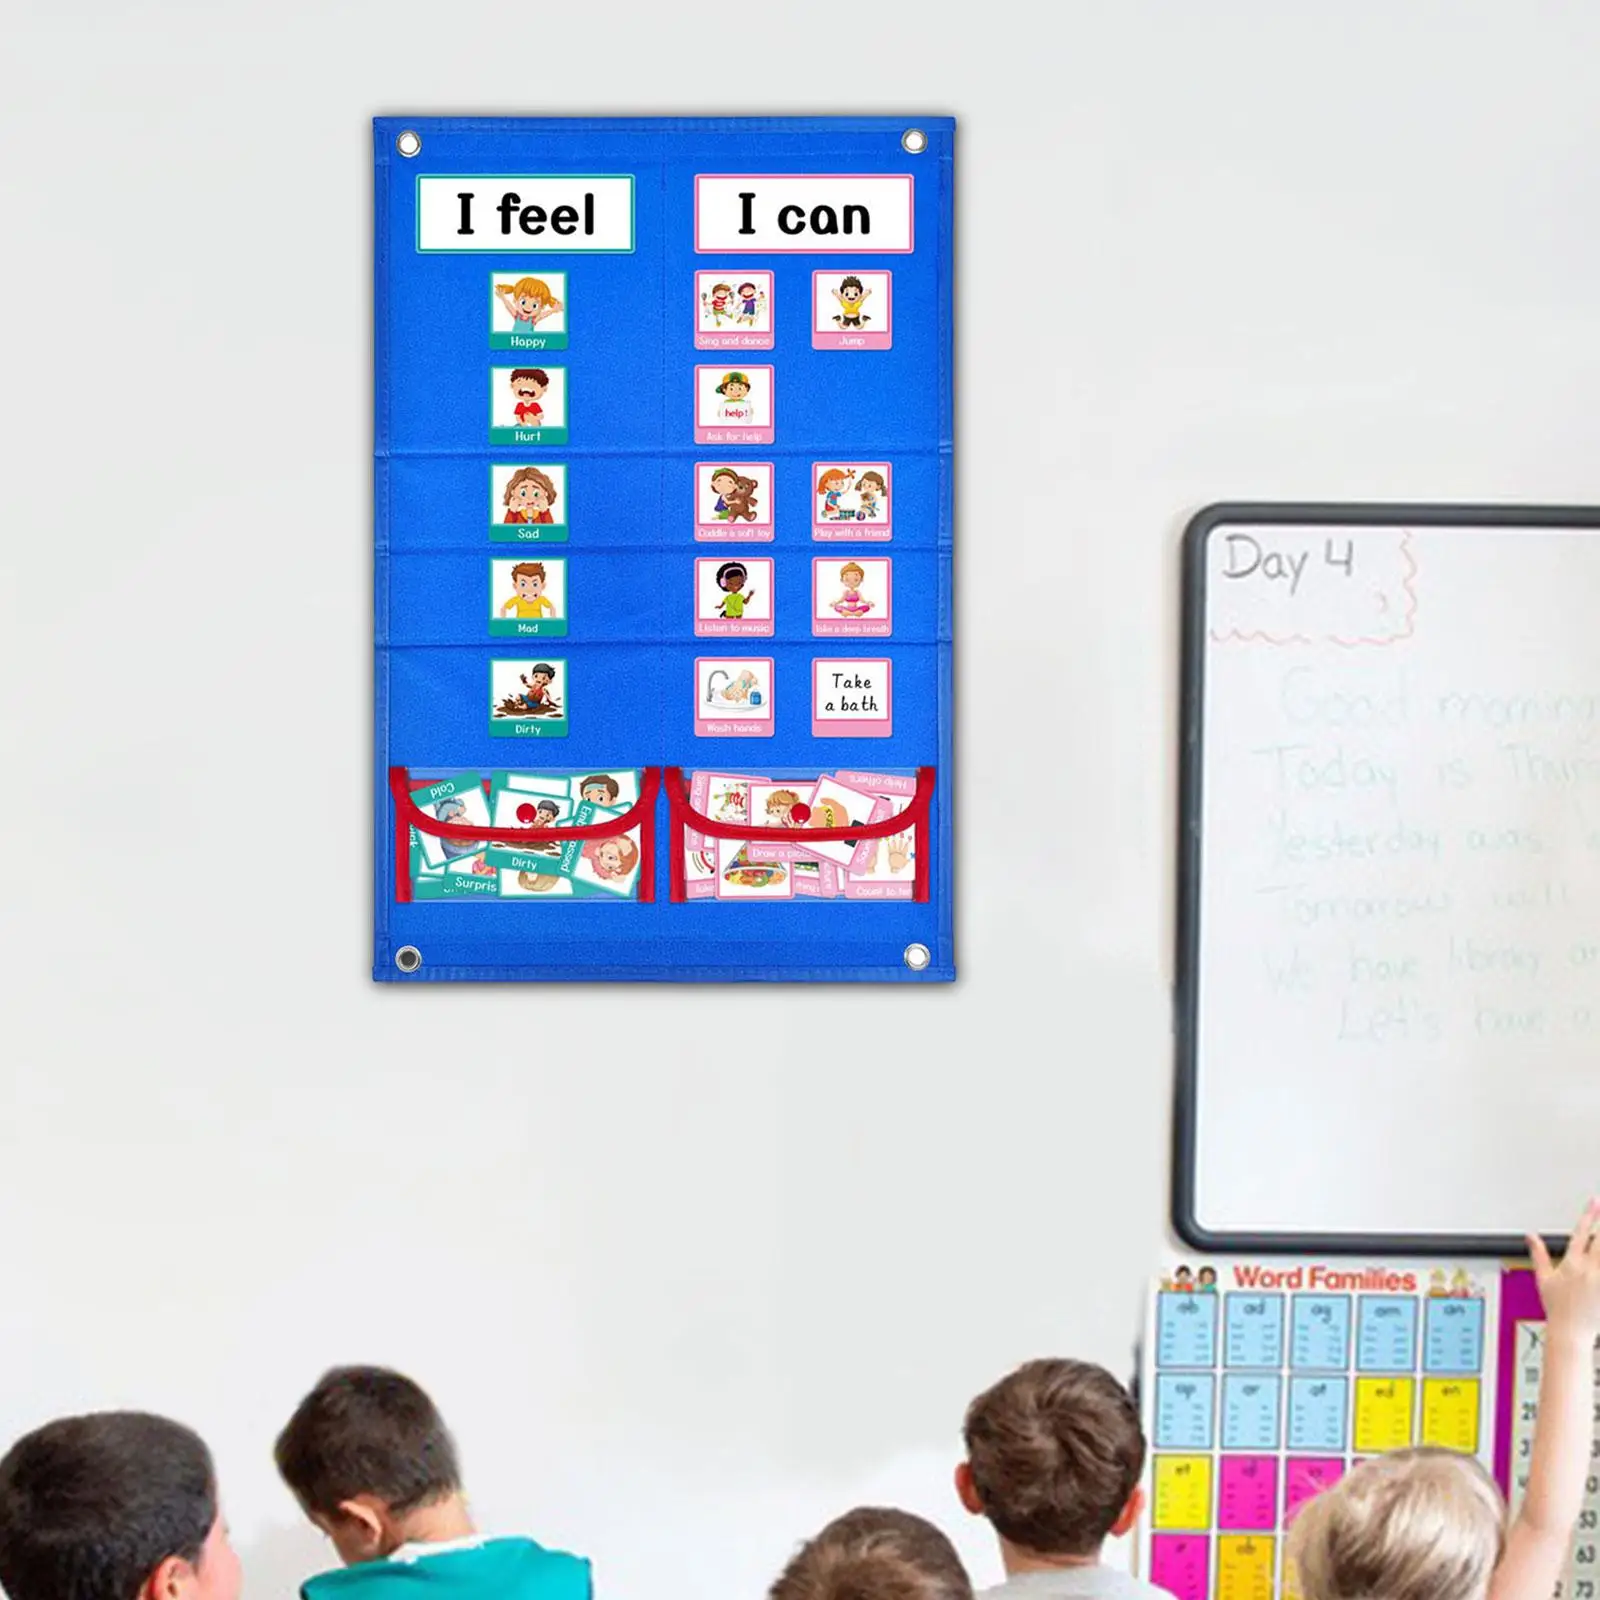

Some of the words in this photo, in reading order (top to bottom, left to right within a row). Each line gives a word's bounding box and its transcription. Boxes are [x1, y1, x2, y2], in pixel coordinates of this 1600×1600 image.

[457, 192, 475, 235] I
[496, 192, 594, 235] feel
[738, 192, 756, 235] I
[777, 204, 870, 235] can
[510, 335, 546, 348] Happy
[698, 335, 719, 347] Sing
[721, 335, 740, 345] and
[741, 335, 771, 345] dance
[838, 335, 866, 347] Jump
[515, 431, 541, 441] Hurt
[706, 431, 721, 441] Ask
[726, 431, 740, 441] for
[743, 431, 762, 443] help
[518, 528, 540, 538] Sad
[698, 528, 728, 538] Cuddle
[737, 528, 755, 538] soft
[757, 528, 771, 539] toy
[814, 528, 832, 539] Play
[834, 528, 854, 538] with
[863, 528, 890, 538] friend
[1223, 533, 1309, 597] Day
[1323, 538, 1355, 577] 4
[518, 624, 539, 633] Mad
[698, 623, 729, 633] Listen
[731, 624, 741, 633] to
[742, 623, 770, 633] music
[832, 673, 872, 689] Take
[825, 701, 835, 711] a
[841, 696, 879, 711] bath
[515, 724, 541, 736] Dirty
[706, 723, 732, 733] Wash
[733, 723, 762, 733] hands
[429, 782, 456, 799] Cold
[560, 806, 593, 873] Embassed
[511, 856, 537, 871] Dirty
[1234, 1265, 1303, 1290] Word
[1309, 1265, 1416, 1292] Families
